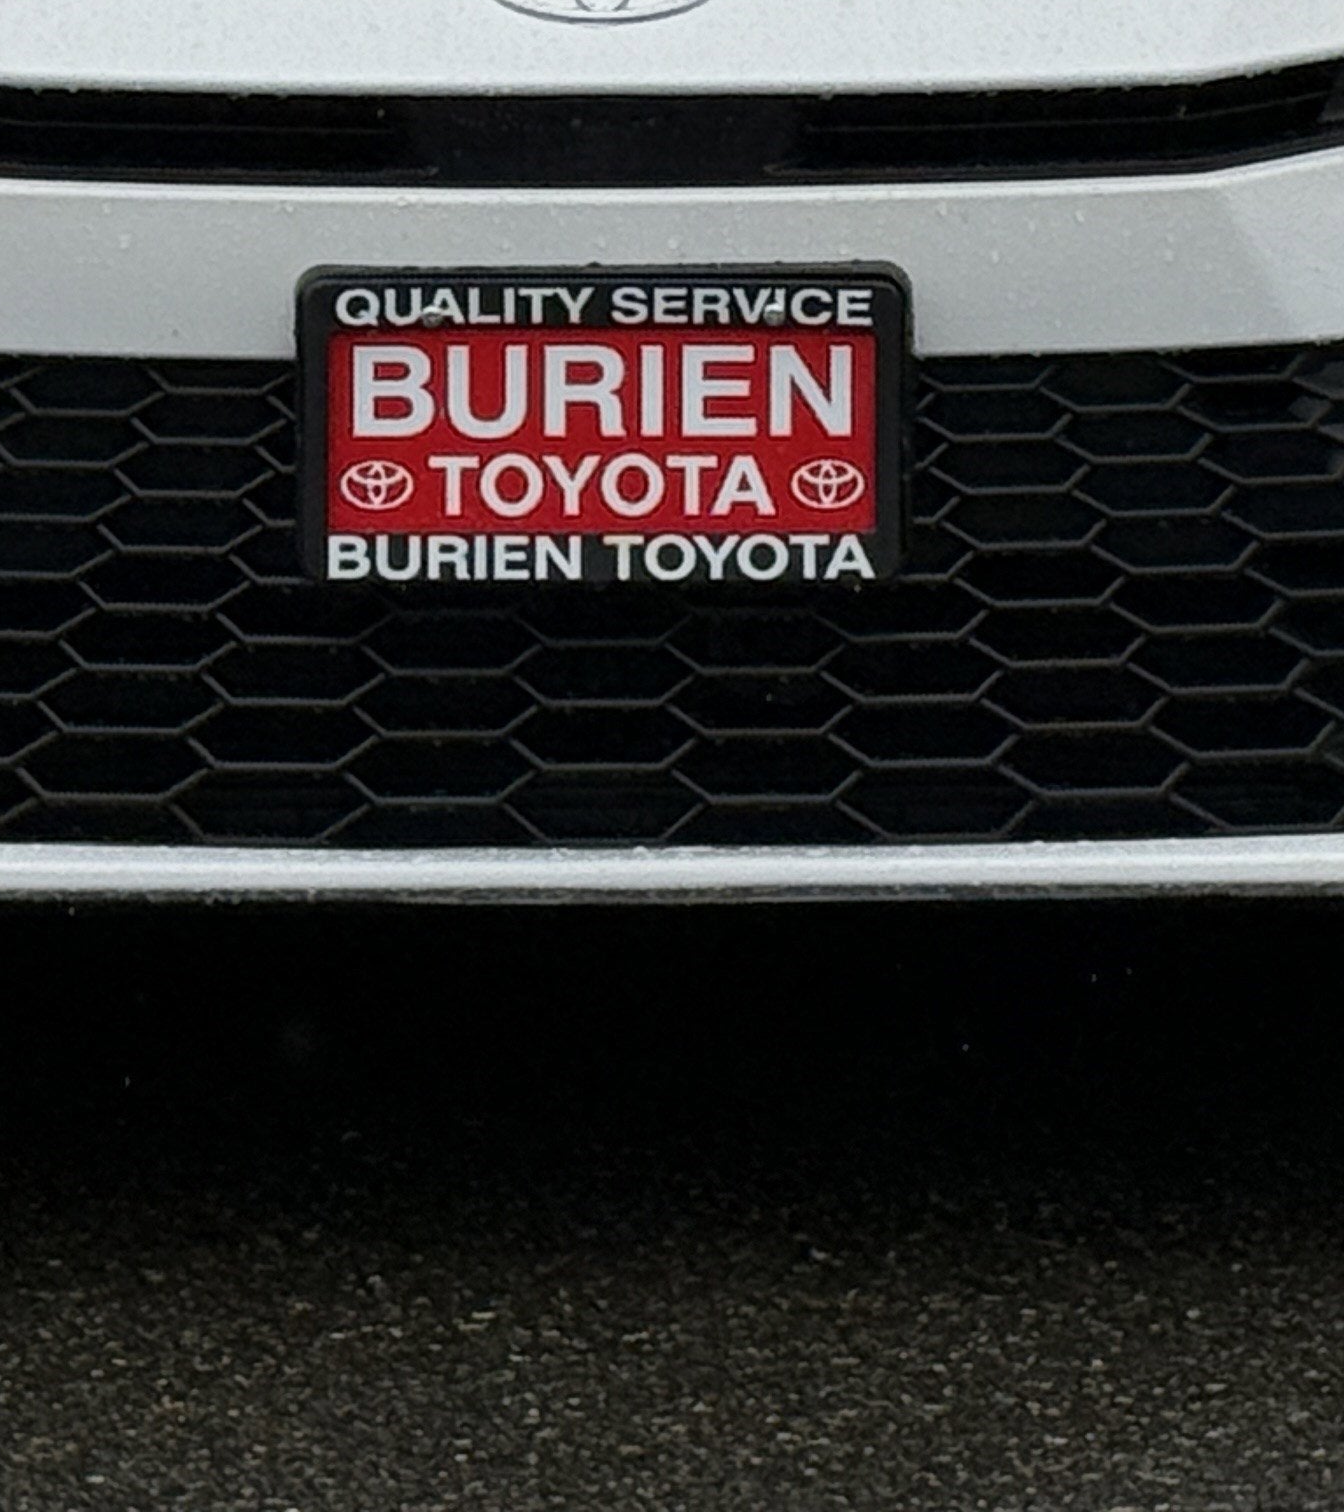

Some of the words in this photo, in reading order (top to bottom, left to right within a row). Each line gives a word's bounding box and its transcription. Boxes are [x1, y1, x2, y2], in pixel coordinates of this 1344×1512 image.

[335, 287, 597, 327] QUALITY
[611, 287, 874, 327] SERVICE
[352, 343, 853, 438] BURIEN
[428, 452, 776, 517] TOYOTA
[327, 533, 582, 580] BURIEN
[602, 534, 876, 580] TOYOTA
